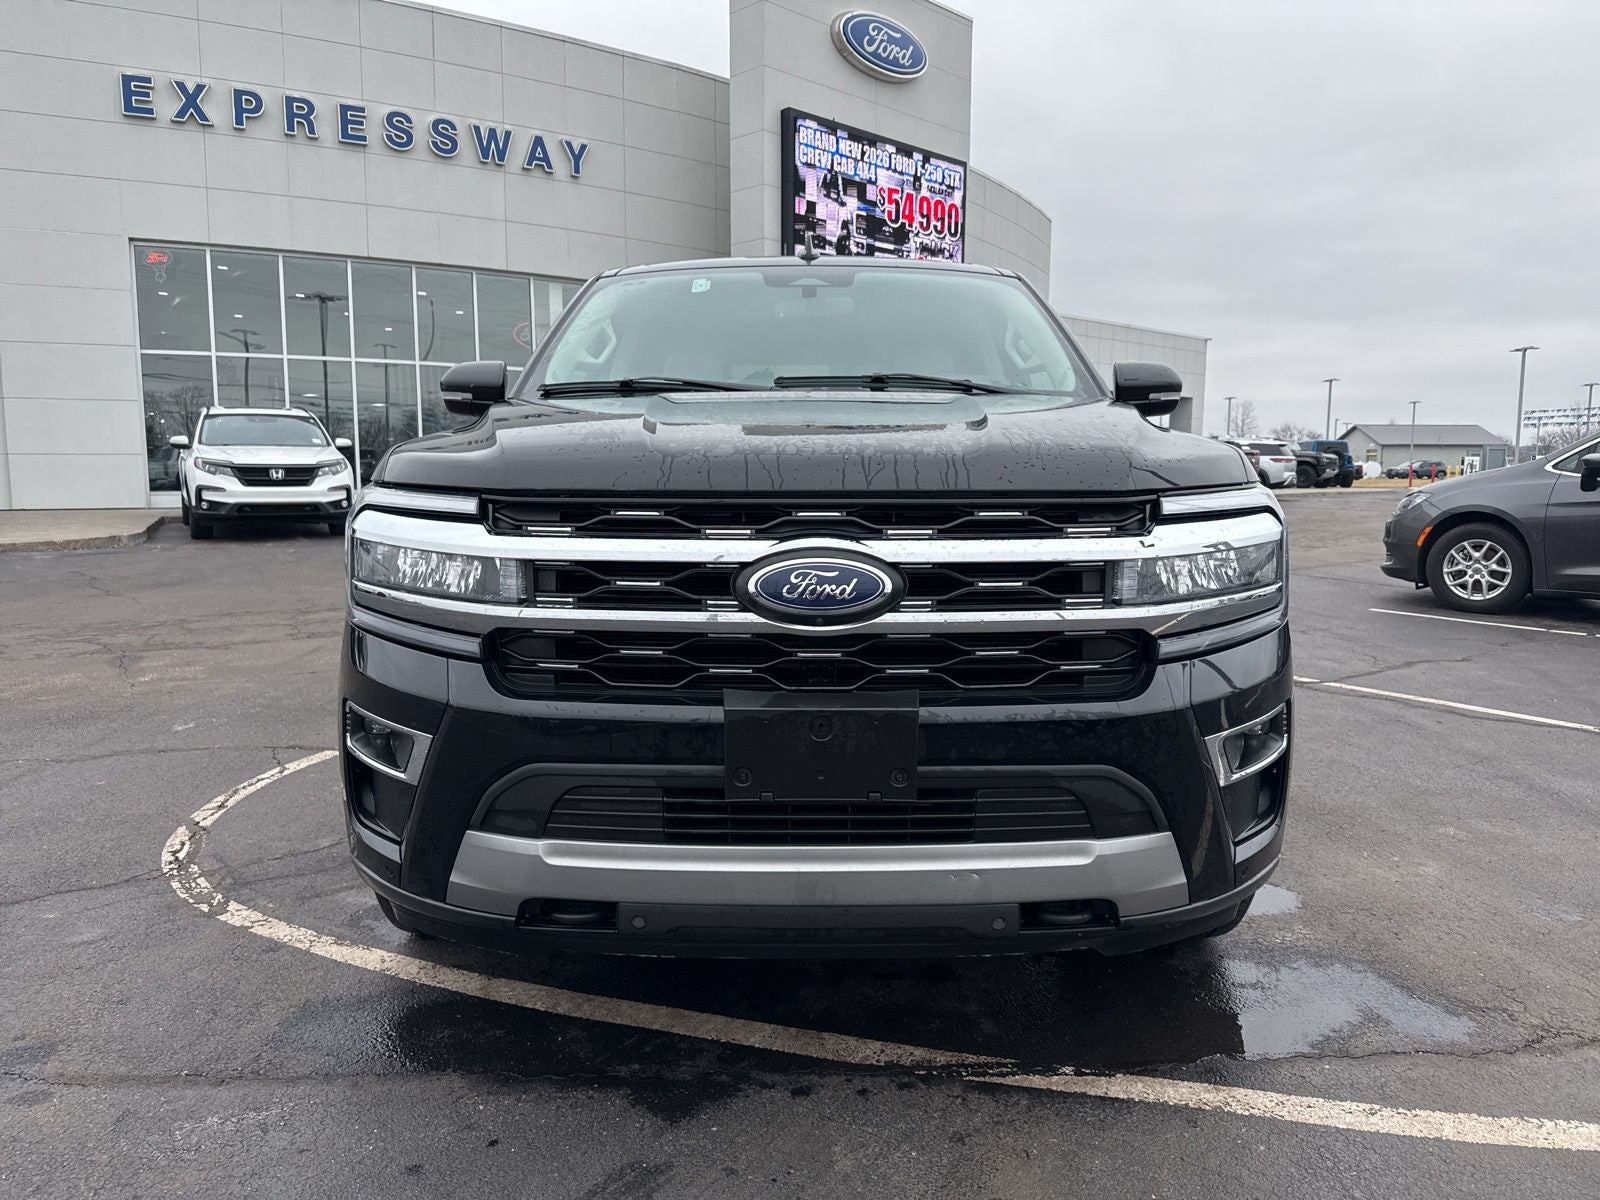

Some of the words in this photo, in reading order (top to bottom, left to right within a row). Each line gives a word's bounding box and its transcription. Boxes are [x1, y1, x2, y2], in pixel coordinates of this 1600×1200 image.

[863, 22, 914, 66] Ford
[119, 72, 590, 177] EXPRESSWAY
[799, 125, 837, 155] BRAND
[838, 136, 863, 160] NEW
[863, 144, 890, 169] 2026
[890, 153, 916, 176] FORD
[916, 160, 943, 183] F-250
[944, 167, 961, 188] STX
[799, 144, 832, 170] CREW
[833, 153, 856, 176] CAB
[782, 569, 858, 600] Ford
